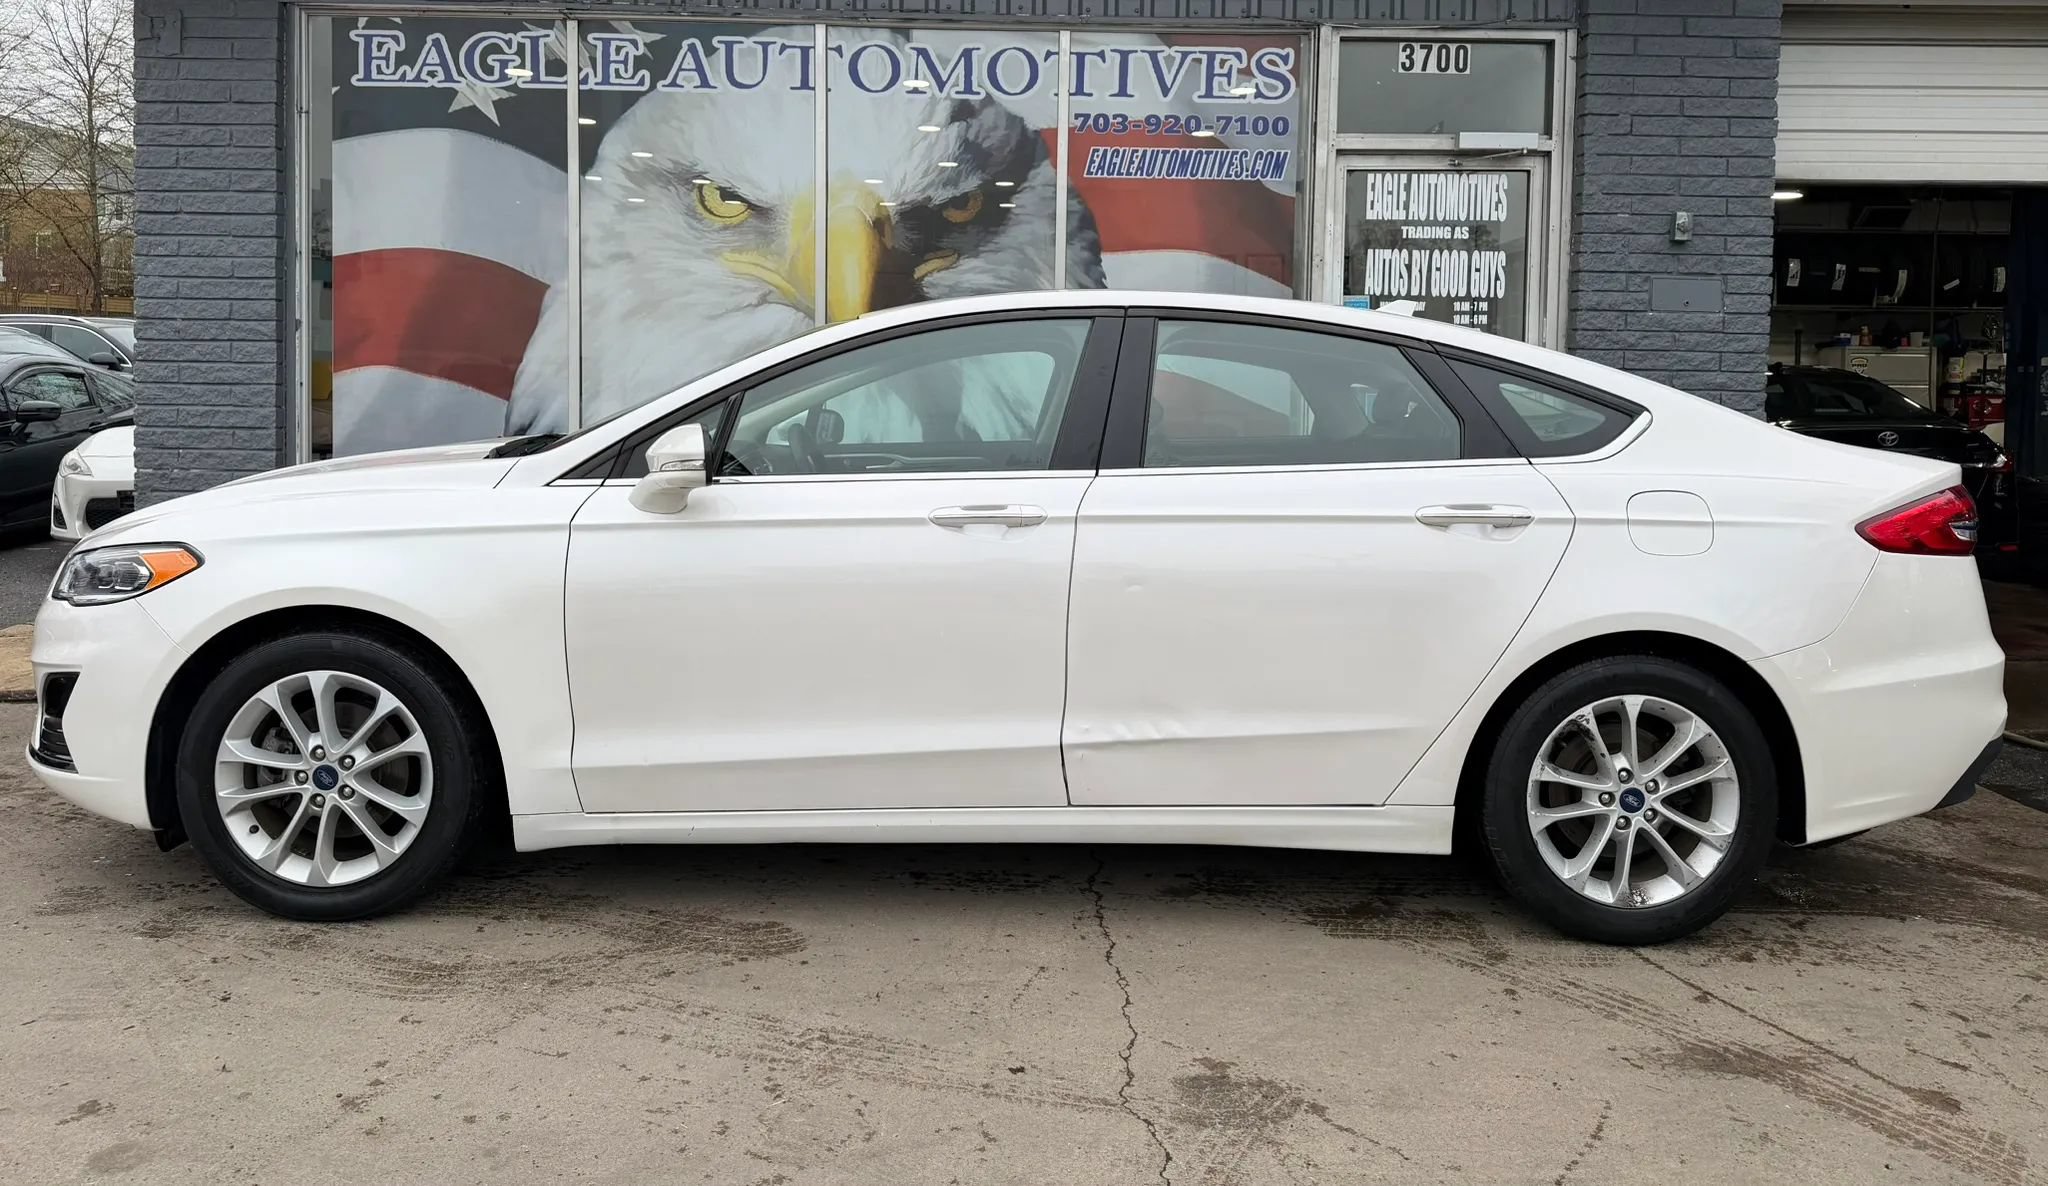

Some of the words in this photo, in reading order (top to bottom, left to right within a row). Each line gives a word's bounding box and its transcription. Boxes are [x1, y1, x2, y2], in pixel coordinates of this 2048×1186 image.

[351, 31, 650, 90] EAGLE
[659, 37, 1296, 103] AUTOMOTIVES
[1400, 43, 1469, 73] 3700
[1073, 112, 1290, 137] 703-920-7100
[1084, 147, 1291, 181] EAGLEAUTOMOTIVES.COM
[1366, 173, 1408, 220] EAGLE
[1408, 173, 1508, 222] AUTOMOTIVES
[1401, 226, 1452, 239] TRADING
[1453, 226, 1470, 239] AS
[1364, 248, 1409, 296] AUTOS
[1410, 249, 1430, 296] BY
[1430, 249, 1469, 297] GOOD
[1470, 250, 1507, 298] GUYS
[1453, 301, 1460, 311] 10
[1460, 301, 1470, 311] AM
[1473, 301, 1478, 311] 7
[1478, 301, 1488, 311] PM
[1453, 314, 1460, 325] 10
[1460, 314, 1470, 324] AM
[1473, 314, 1478, 324] 6
[1478, 314, 1488, 324] PM
